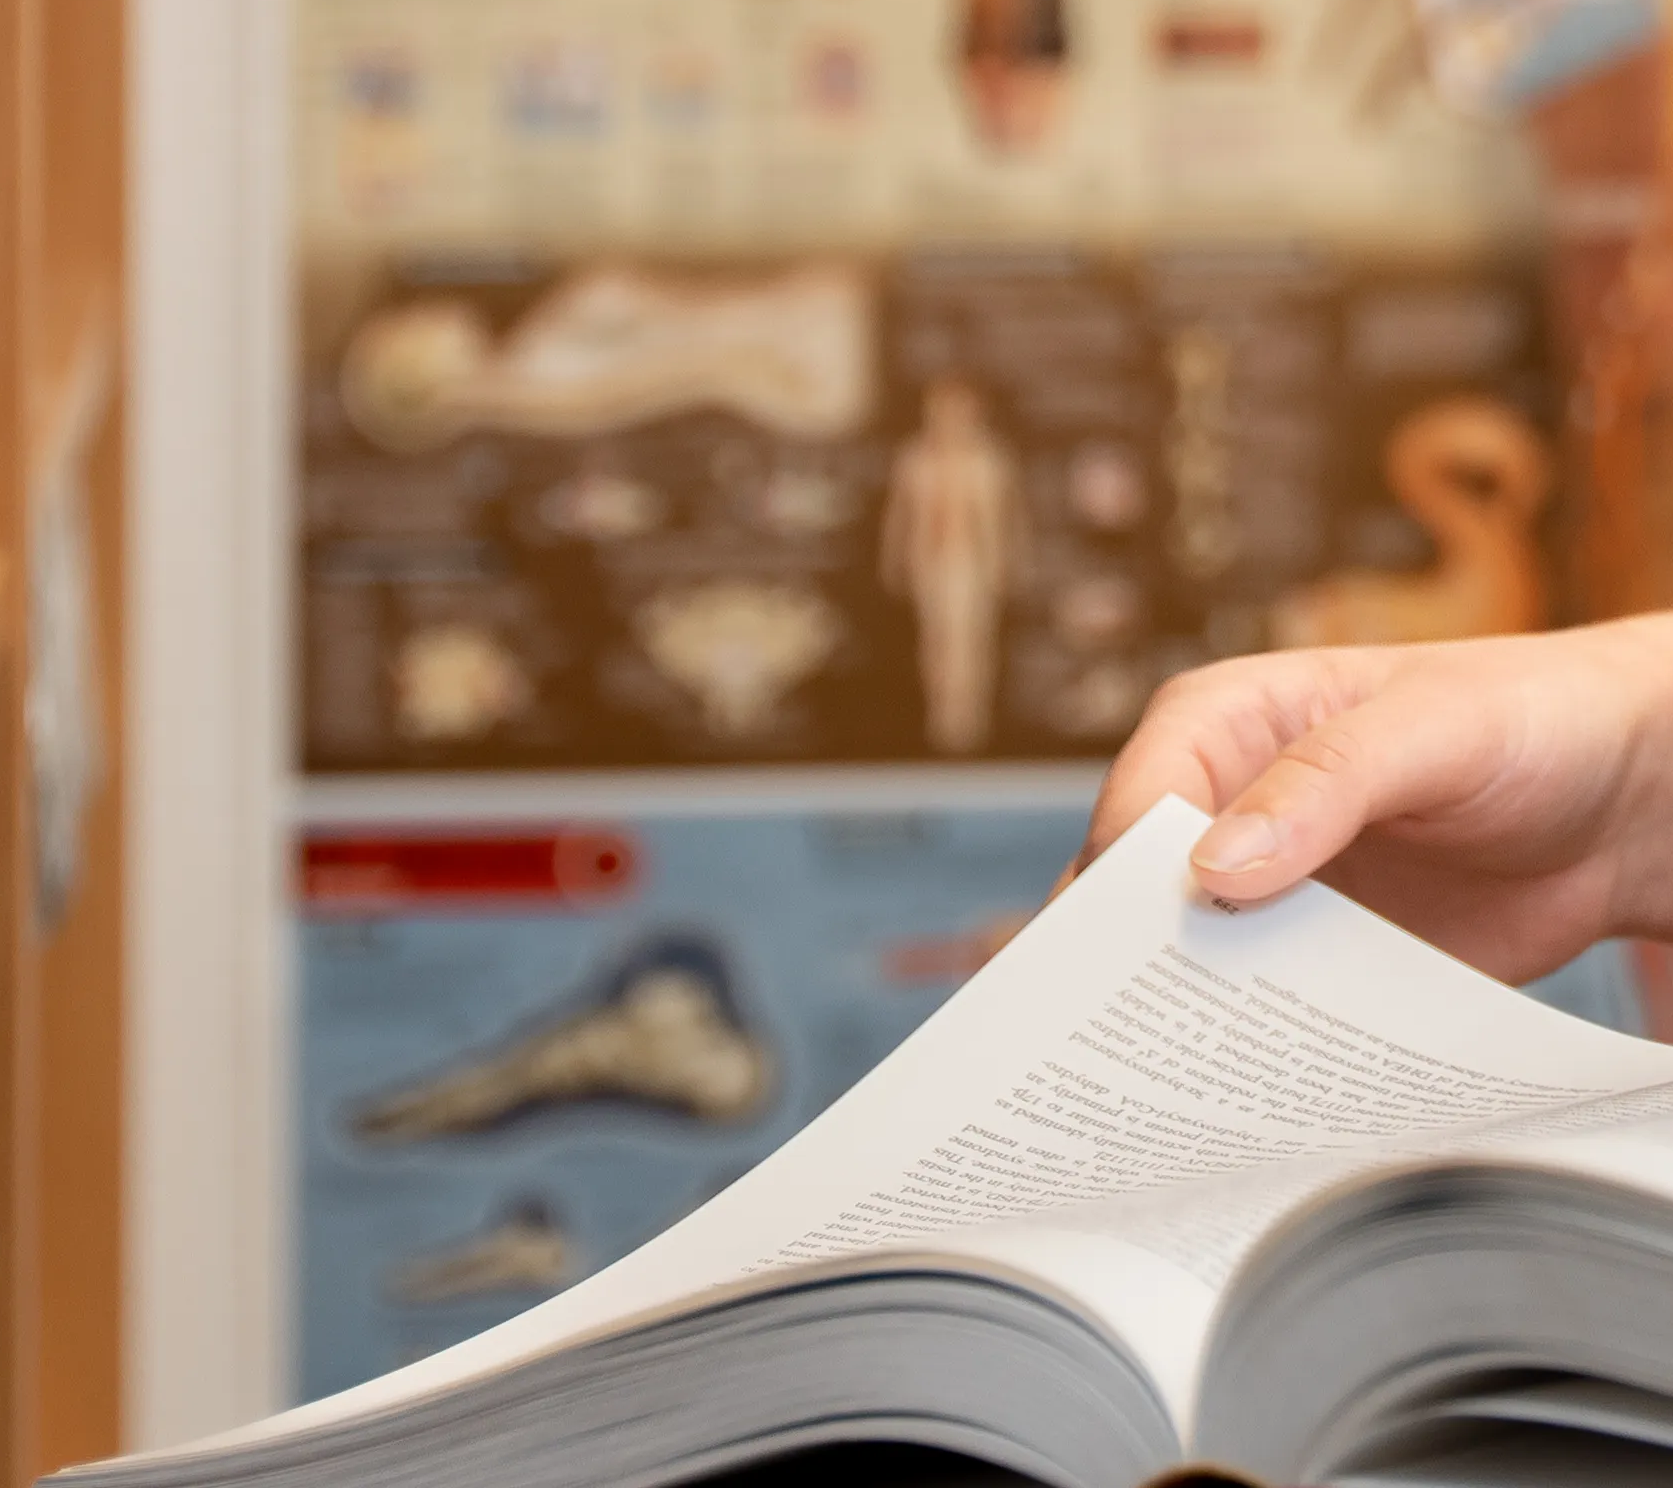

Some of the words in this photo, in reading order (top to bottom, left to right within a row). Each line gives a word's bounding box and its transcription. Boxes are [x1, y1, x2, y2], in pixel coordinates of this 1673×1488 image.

[1129, 974, 1191, 1011] enzyme
[1144, 959, 1270, 1032] androstenedione
[1114, 988, 1168, 1022] widely
[1172, 1019, 1190, 1034] is
[1189, 1008, 1218, 1028] the
[1301, 1002, 1367, 1038] anabolic
[1086, 1018, 1139, 1048] andro-
[1159, 1034, 1176, 1049] is
[1191, 1030, 1209, 1045] It
[1217, 1022, 1291, 1060] probably
[1173, 1042, 1208, 1062] role
[1383, 1041, 1445, 1068] steroids
[1067, 1030, 1211, 1102] 3α-hydroxysteroid
[1205, 1056, 1265, 1085] precise
[1302, 1063, 1339, 1079] and
[1024, 1070, 1048, 1086] an
[1040, 1060, 1112, 1097] dehydro-
[1183, 1066, 1259, 1101] reduction
[1294, 1076, 1334, 1096] been
[1338, 1075, 1392, 1097] tissues
[1010, 1086, 1043, 1107] 17β-
[1047, 1082, 1127, 1118] primarily
[1259, 1096, 1289, 1110] the
[1277, 1086, 1309, 1103] but
[1010, 1106, 1089, 1141] identified
[1064, 1110, 1123, 1134] similar
[1143, 1120, 1204, 1142] protein
[1259, 1111, 1316, 1130] cloned
[960, 1122, 1020, 1150] termed
[1086, 1133, 1150, 1157] initially
[1123, 1129, 1194, 1152] activities
[1273, 1138, 1309, 1152] and
[931, 1146, 967, 1166] This
[947, 1135, 1027, 1166] syndrome
[1025, 1145, 1067, 1162] often
[916, 1158, 958, 1177] testis
[1027, 1162, 1081, 1178] classic
[1093, 1163, 1141, 1178] which
[901, 1170, 955, 1190] micro-
[853, 1201, 894, 1217] from
[868, 1191, 961, 1216] testosterone
